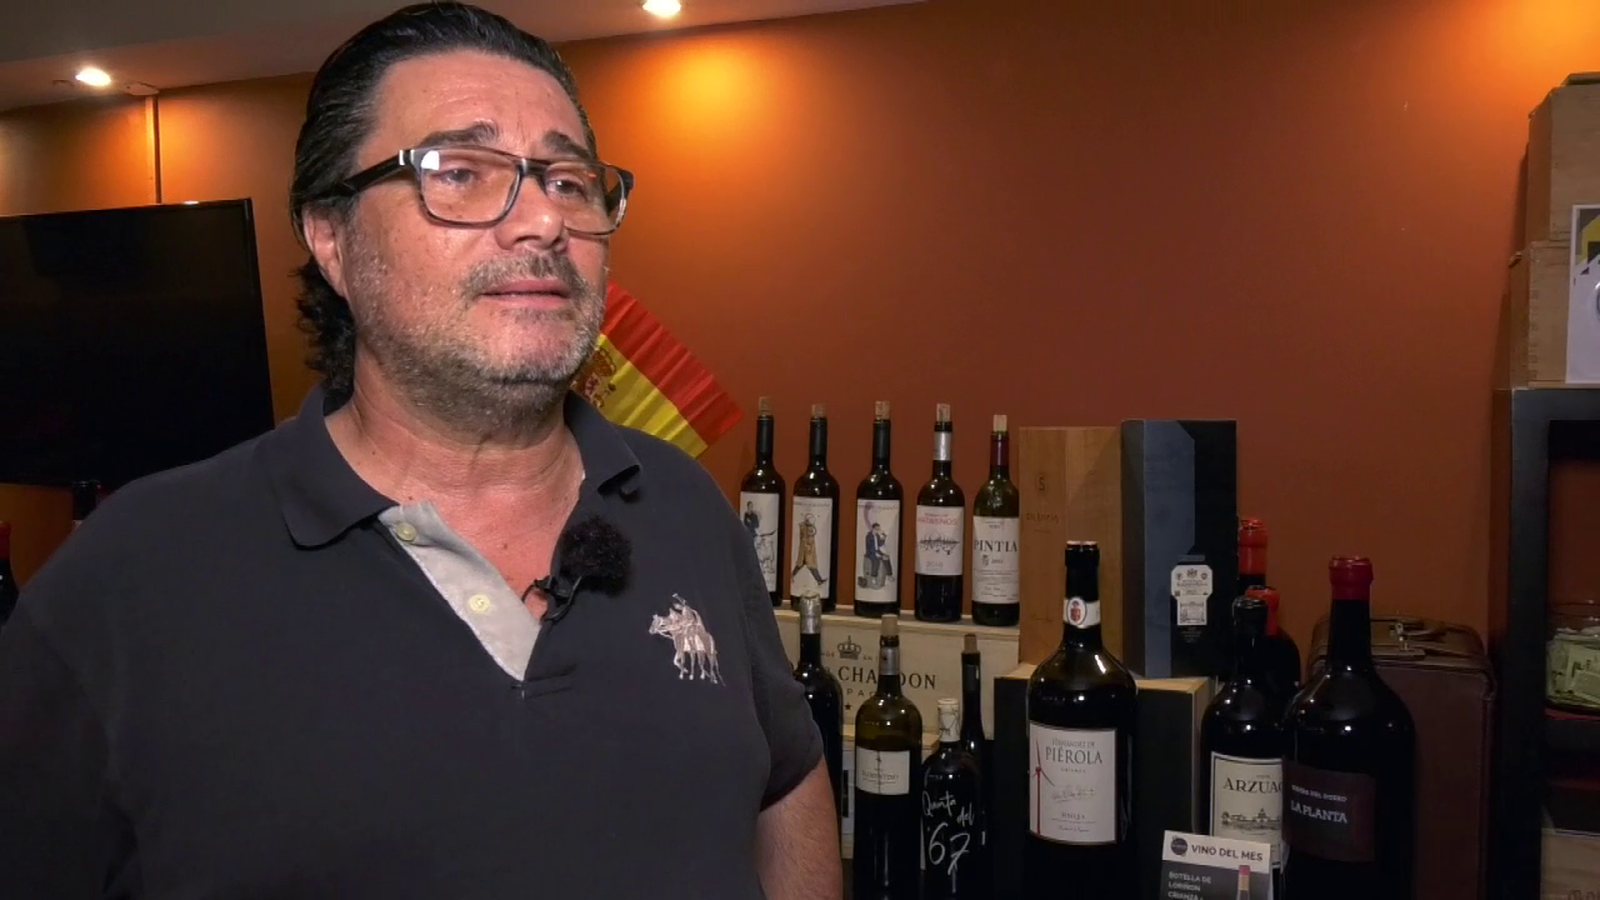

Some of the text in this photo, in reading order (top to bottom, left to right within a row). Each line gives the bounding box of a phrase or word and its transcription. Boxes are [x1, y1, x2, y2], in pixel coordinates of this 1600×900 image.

[974, 540, 1018, 552] PINTIA
[1045, 745, 1103, 764] PIÉROLA
[1291, 799, 1348, 824] LA PLANTA
[1191, 844, 1217, 856] VINO
[1219, 848, 1239, 859] DEL
[1241, 851, 1263, 862] MES
[1168, 871, 1212, 884] BOTELLA DE
